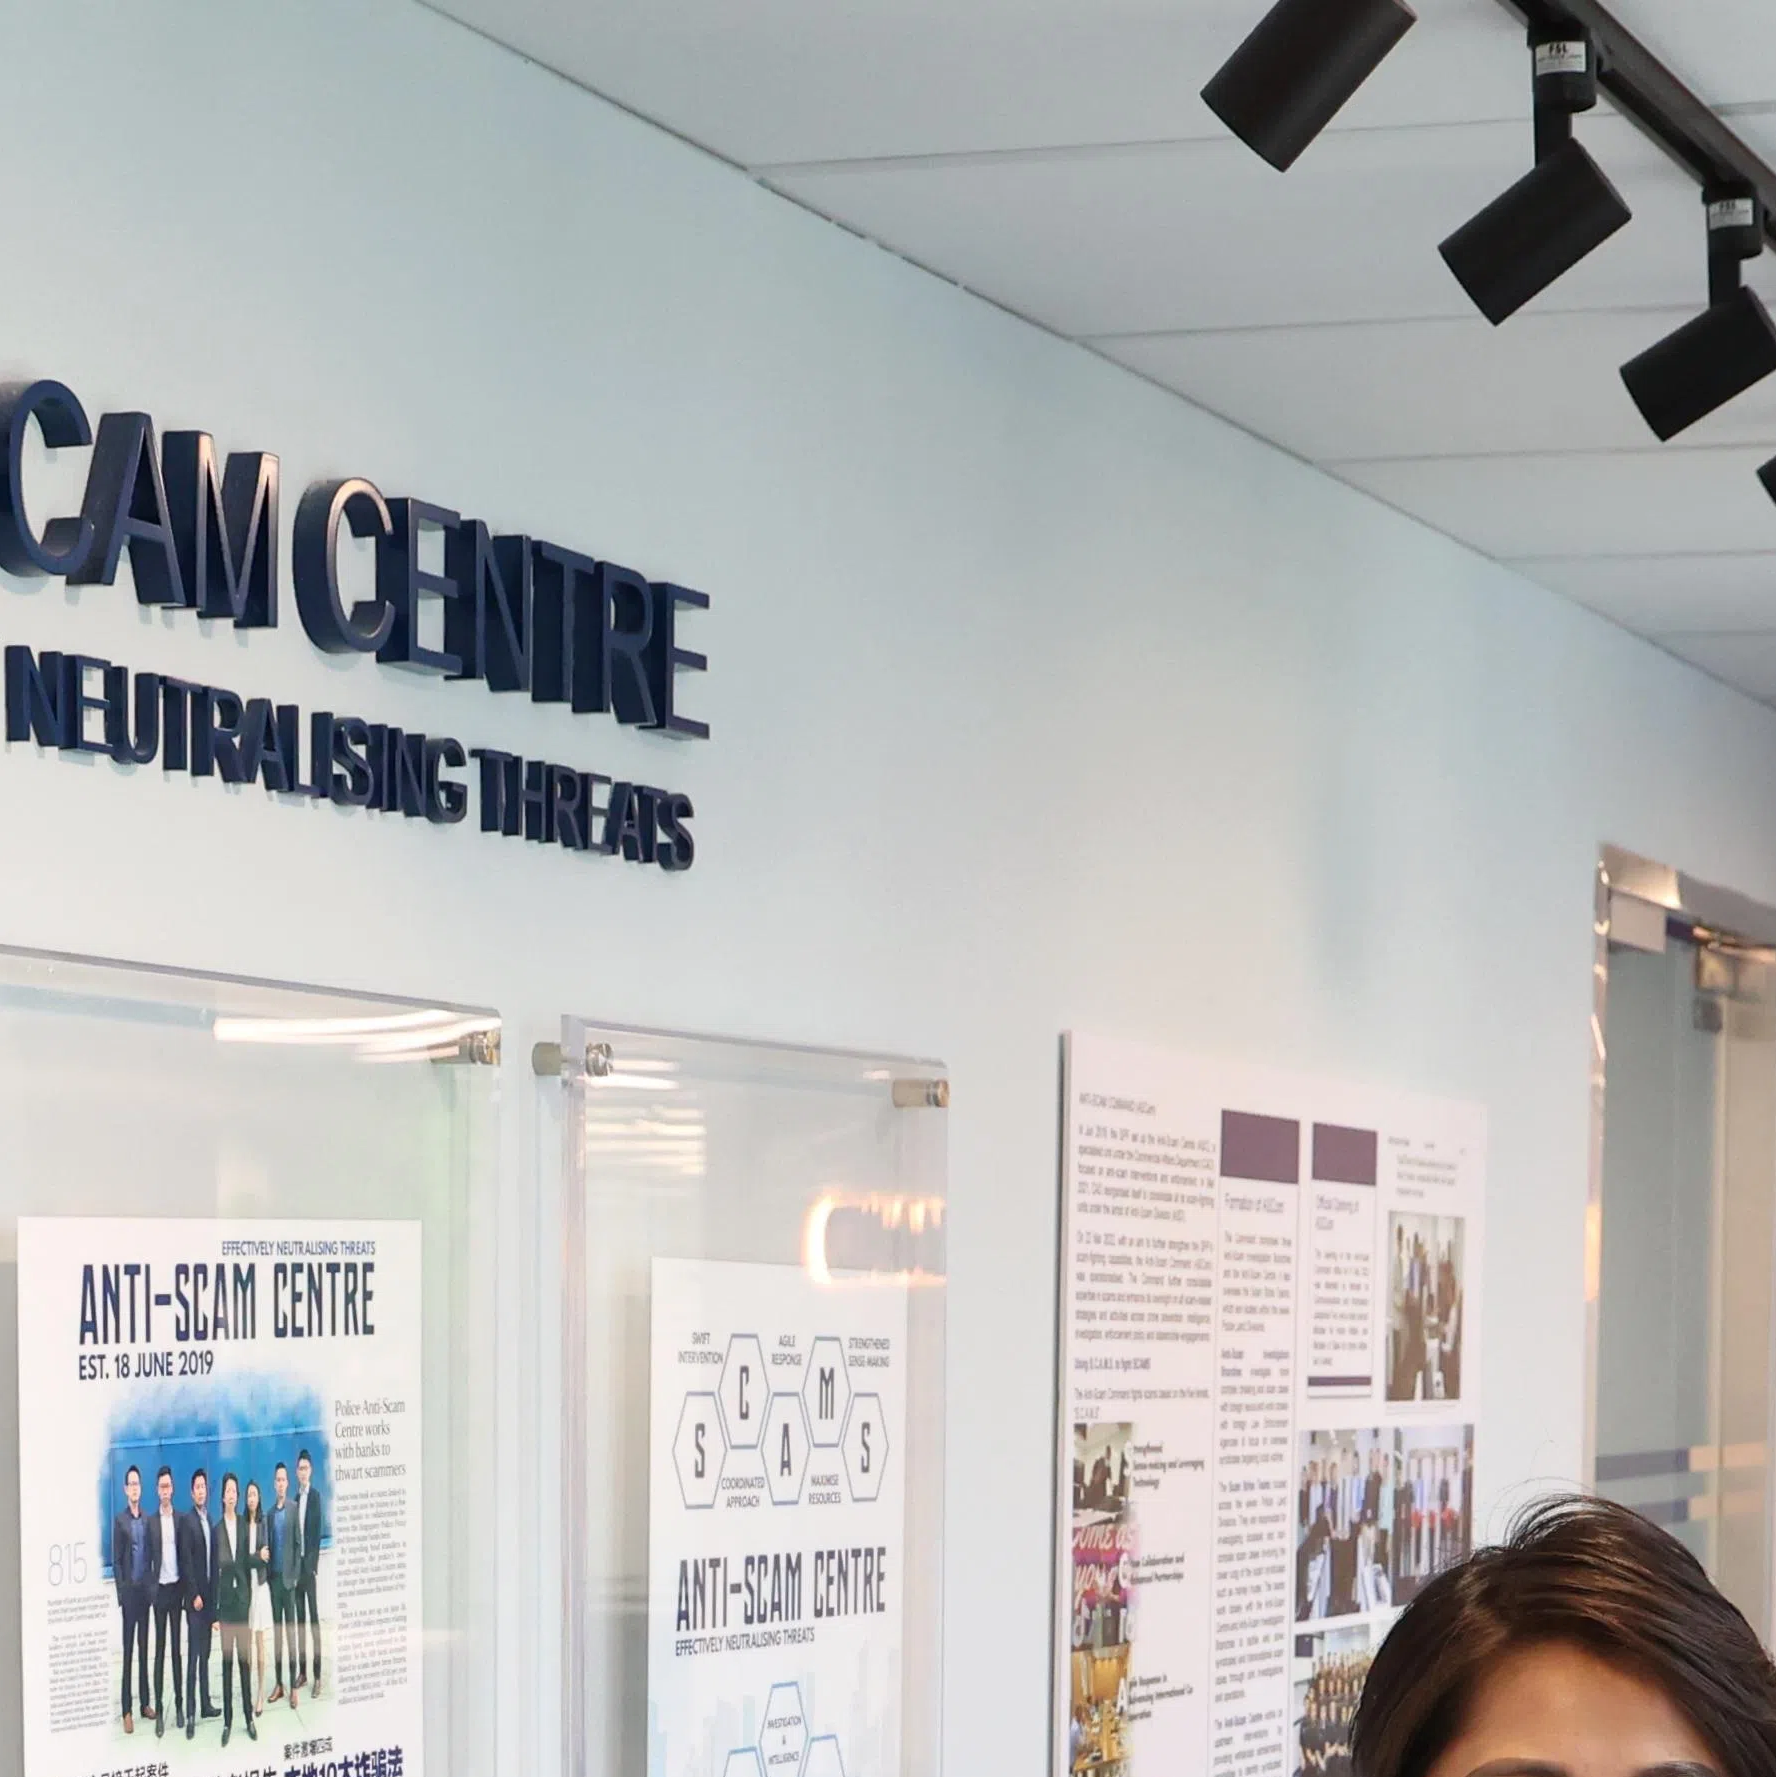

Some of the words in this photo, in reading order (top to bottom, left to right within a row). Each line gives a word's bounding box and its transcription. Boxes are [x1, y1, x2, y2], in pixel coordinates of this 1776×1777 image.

[292, 477, 711, 739] CENTRE
[6, 645, 467, 825] NEUTRALISING
[469, 748, 694, 870] THREATS
[222, 1240, 274, 1255] EFFECTIVELY
[277, 1240, 338, 1255] NEUTRALISING
[341, 1240, 375, 1255] THREATS
[79, 1263, 256, 1344] ANTI-SCAM
[274, 1262, 375, 1338] CENTRE
[79, 1355, 109, 1380] EST.
[115, 1354, 130, 1378] 18
[135, 1352, 173, 1377] JUNE
[178, 1350, 214, 1376] 2019
[739, 1365, 749, 1420] C
[819, 1367, 834, 1420] M
[335, 1422, 363, 1438] Centre
[365, 1419, 390, 1435] works
[694, 1422, 706, 1478] S
[780, 1423, 791, 1477] A
[861, 1421, 871, 1473] S
[48, 1542, 89, 1587] 815
[676, 1551, 802, 1632] ANTI-SCAM
[814, 1546, 886, 1618] CENTRE
[675, 1636, 724, 1657] EFFECTIVELY
[725, 1630, 782, 1650] NEUTRALISING
[783, 1627, 815, 1644] THREATS
